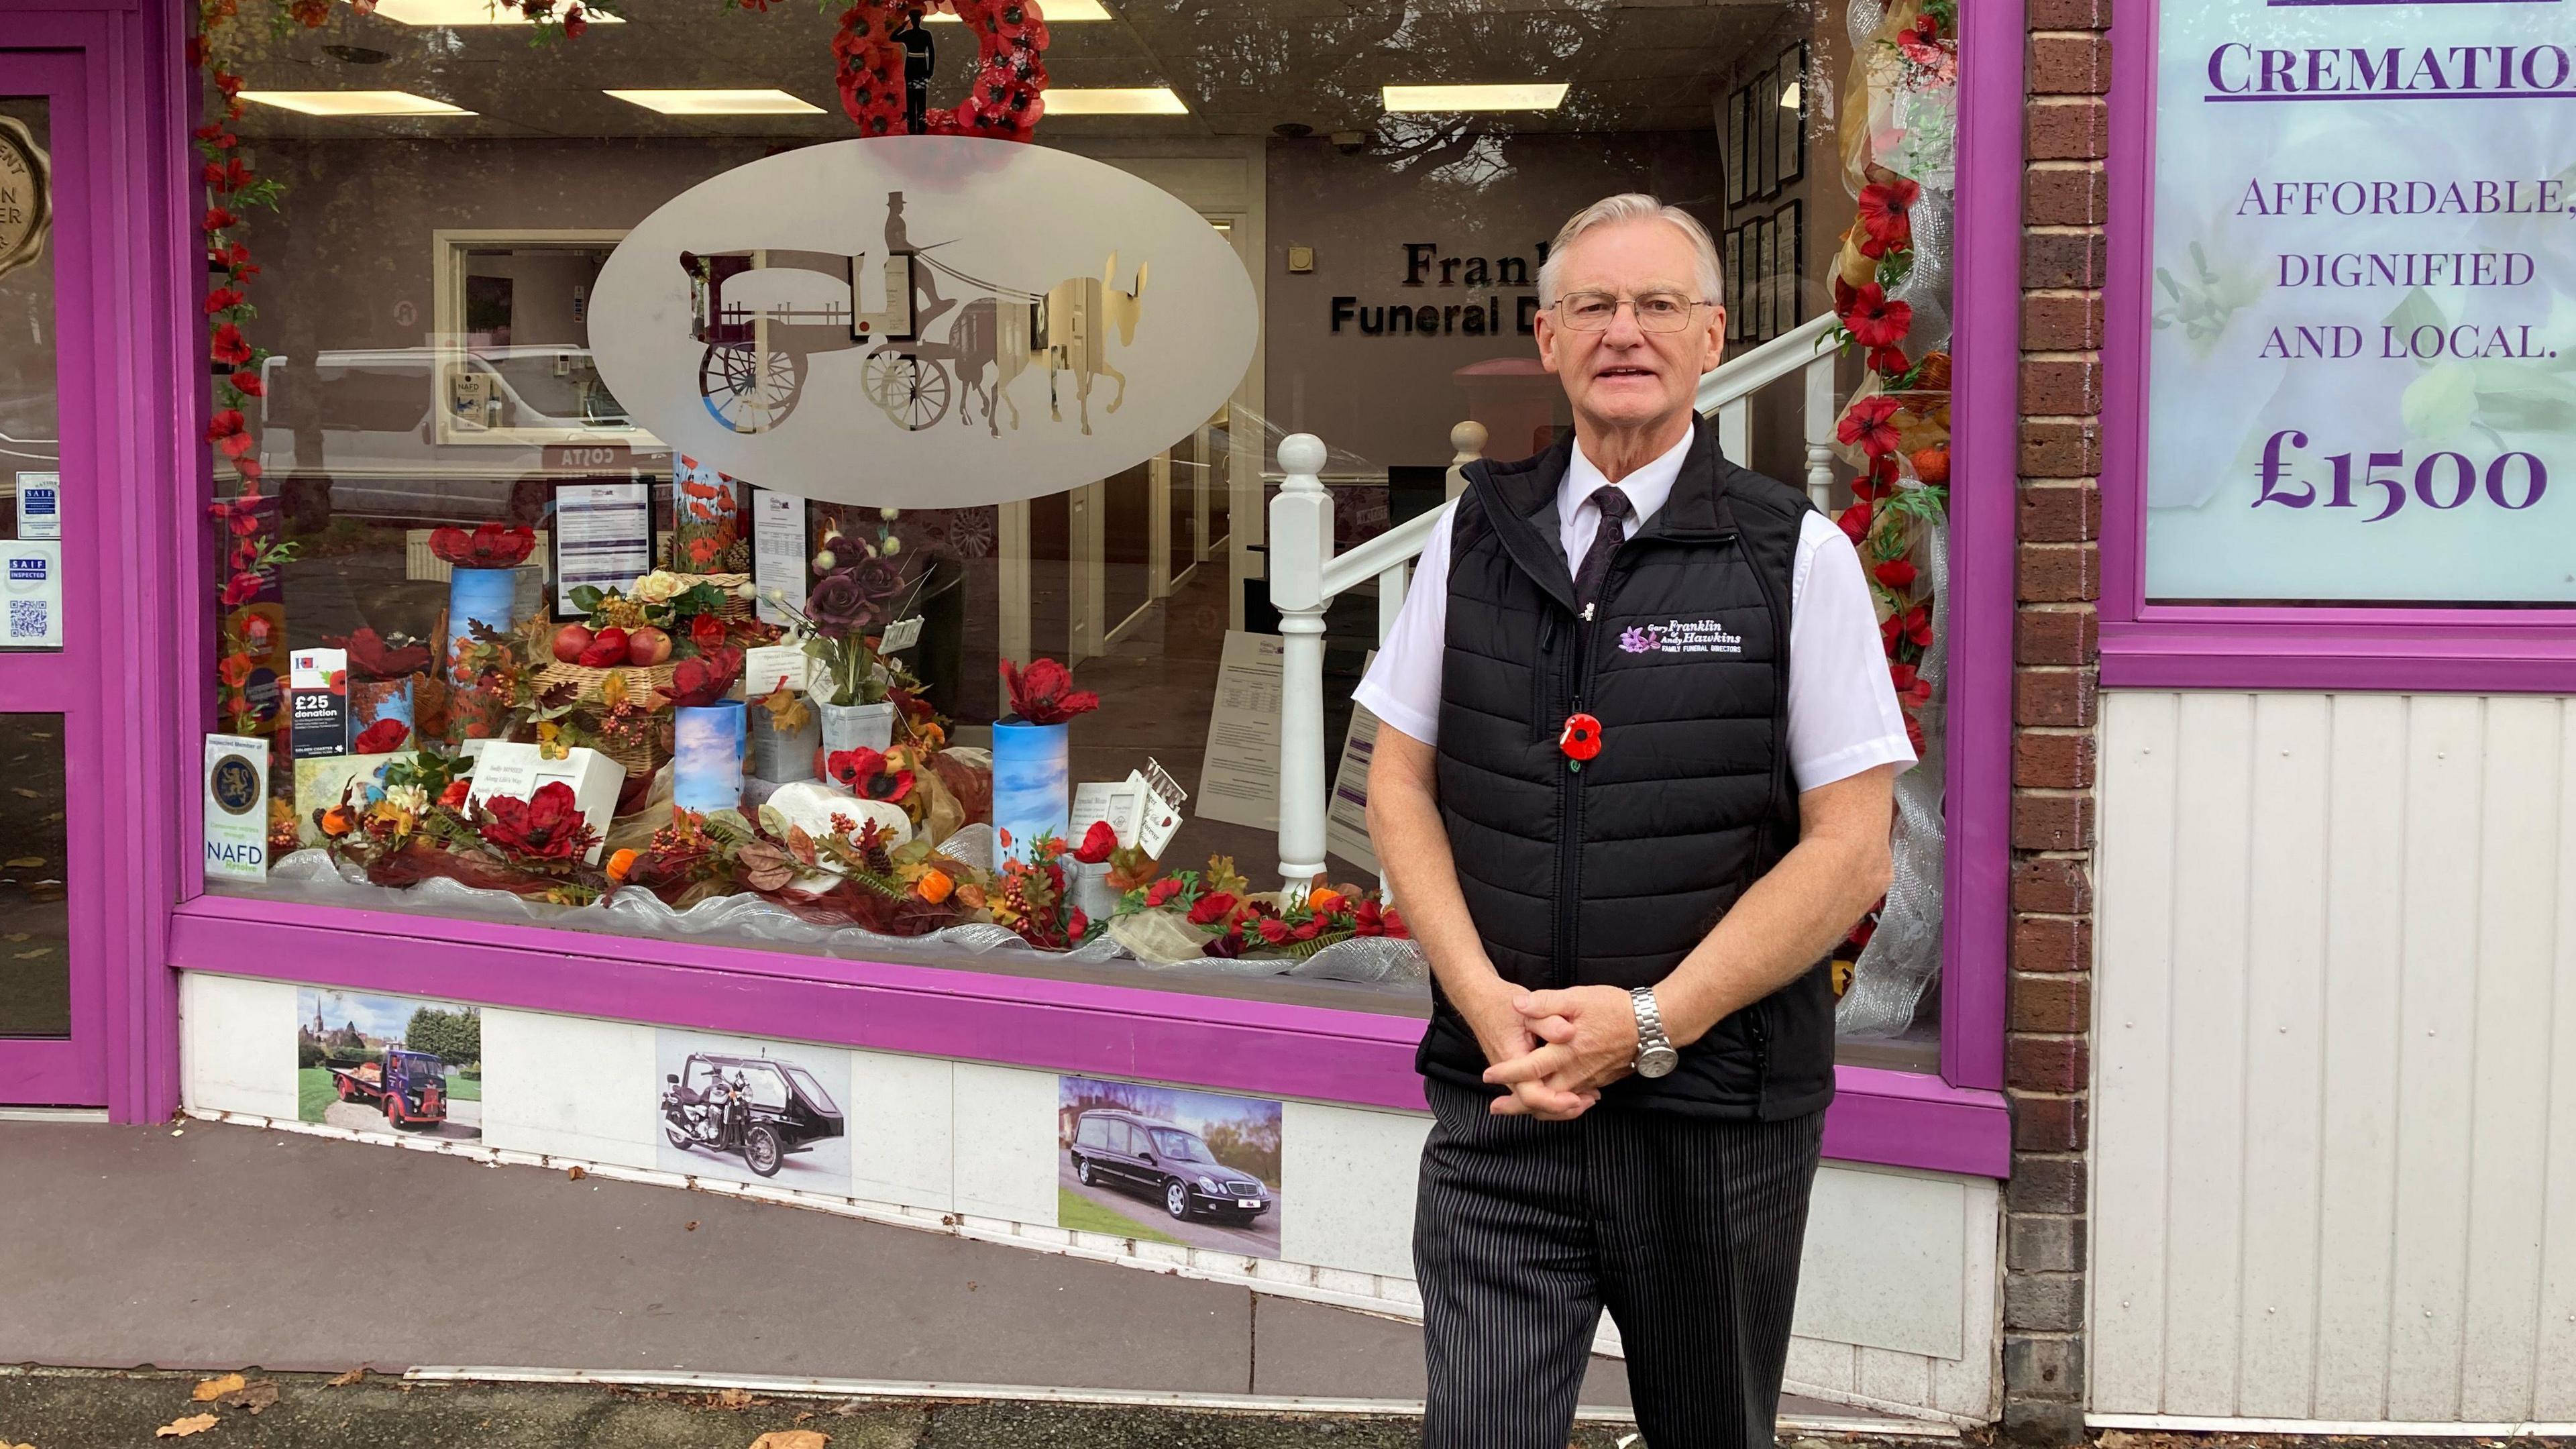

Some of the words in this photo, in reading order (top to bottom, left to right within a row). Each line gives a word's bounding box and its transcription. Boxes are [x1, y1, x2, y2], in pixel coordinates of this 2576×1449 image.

[2208, 42, 2576, 93] CREMATIO
[2237, 177, 2576, 219] AFFORDABLE,
[2277, 252, 2535, 288] DIGNIFIED
[1331, 296, 1498, 333] Funeral
[2259, 325, 2363, 359] AND
[2379, 324, 2557, 359] LOCAL.
[2251, 430, 2548, 523] £1500
[12, 560, 43, 569] SAIF
[1668, 620, 1722, 632] Franklin
[1660, 636, 1682, 646] Andy
[1682, 632, 1741, 643] Hawkins
[295, 695, 329, 710] £25
[295, 709, 337, 718] donation
[208, 841, 262, 864] NAFD
[225, 859, 258, 872] Resolve
